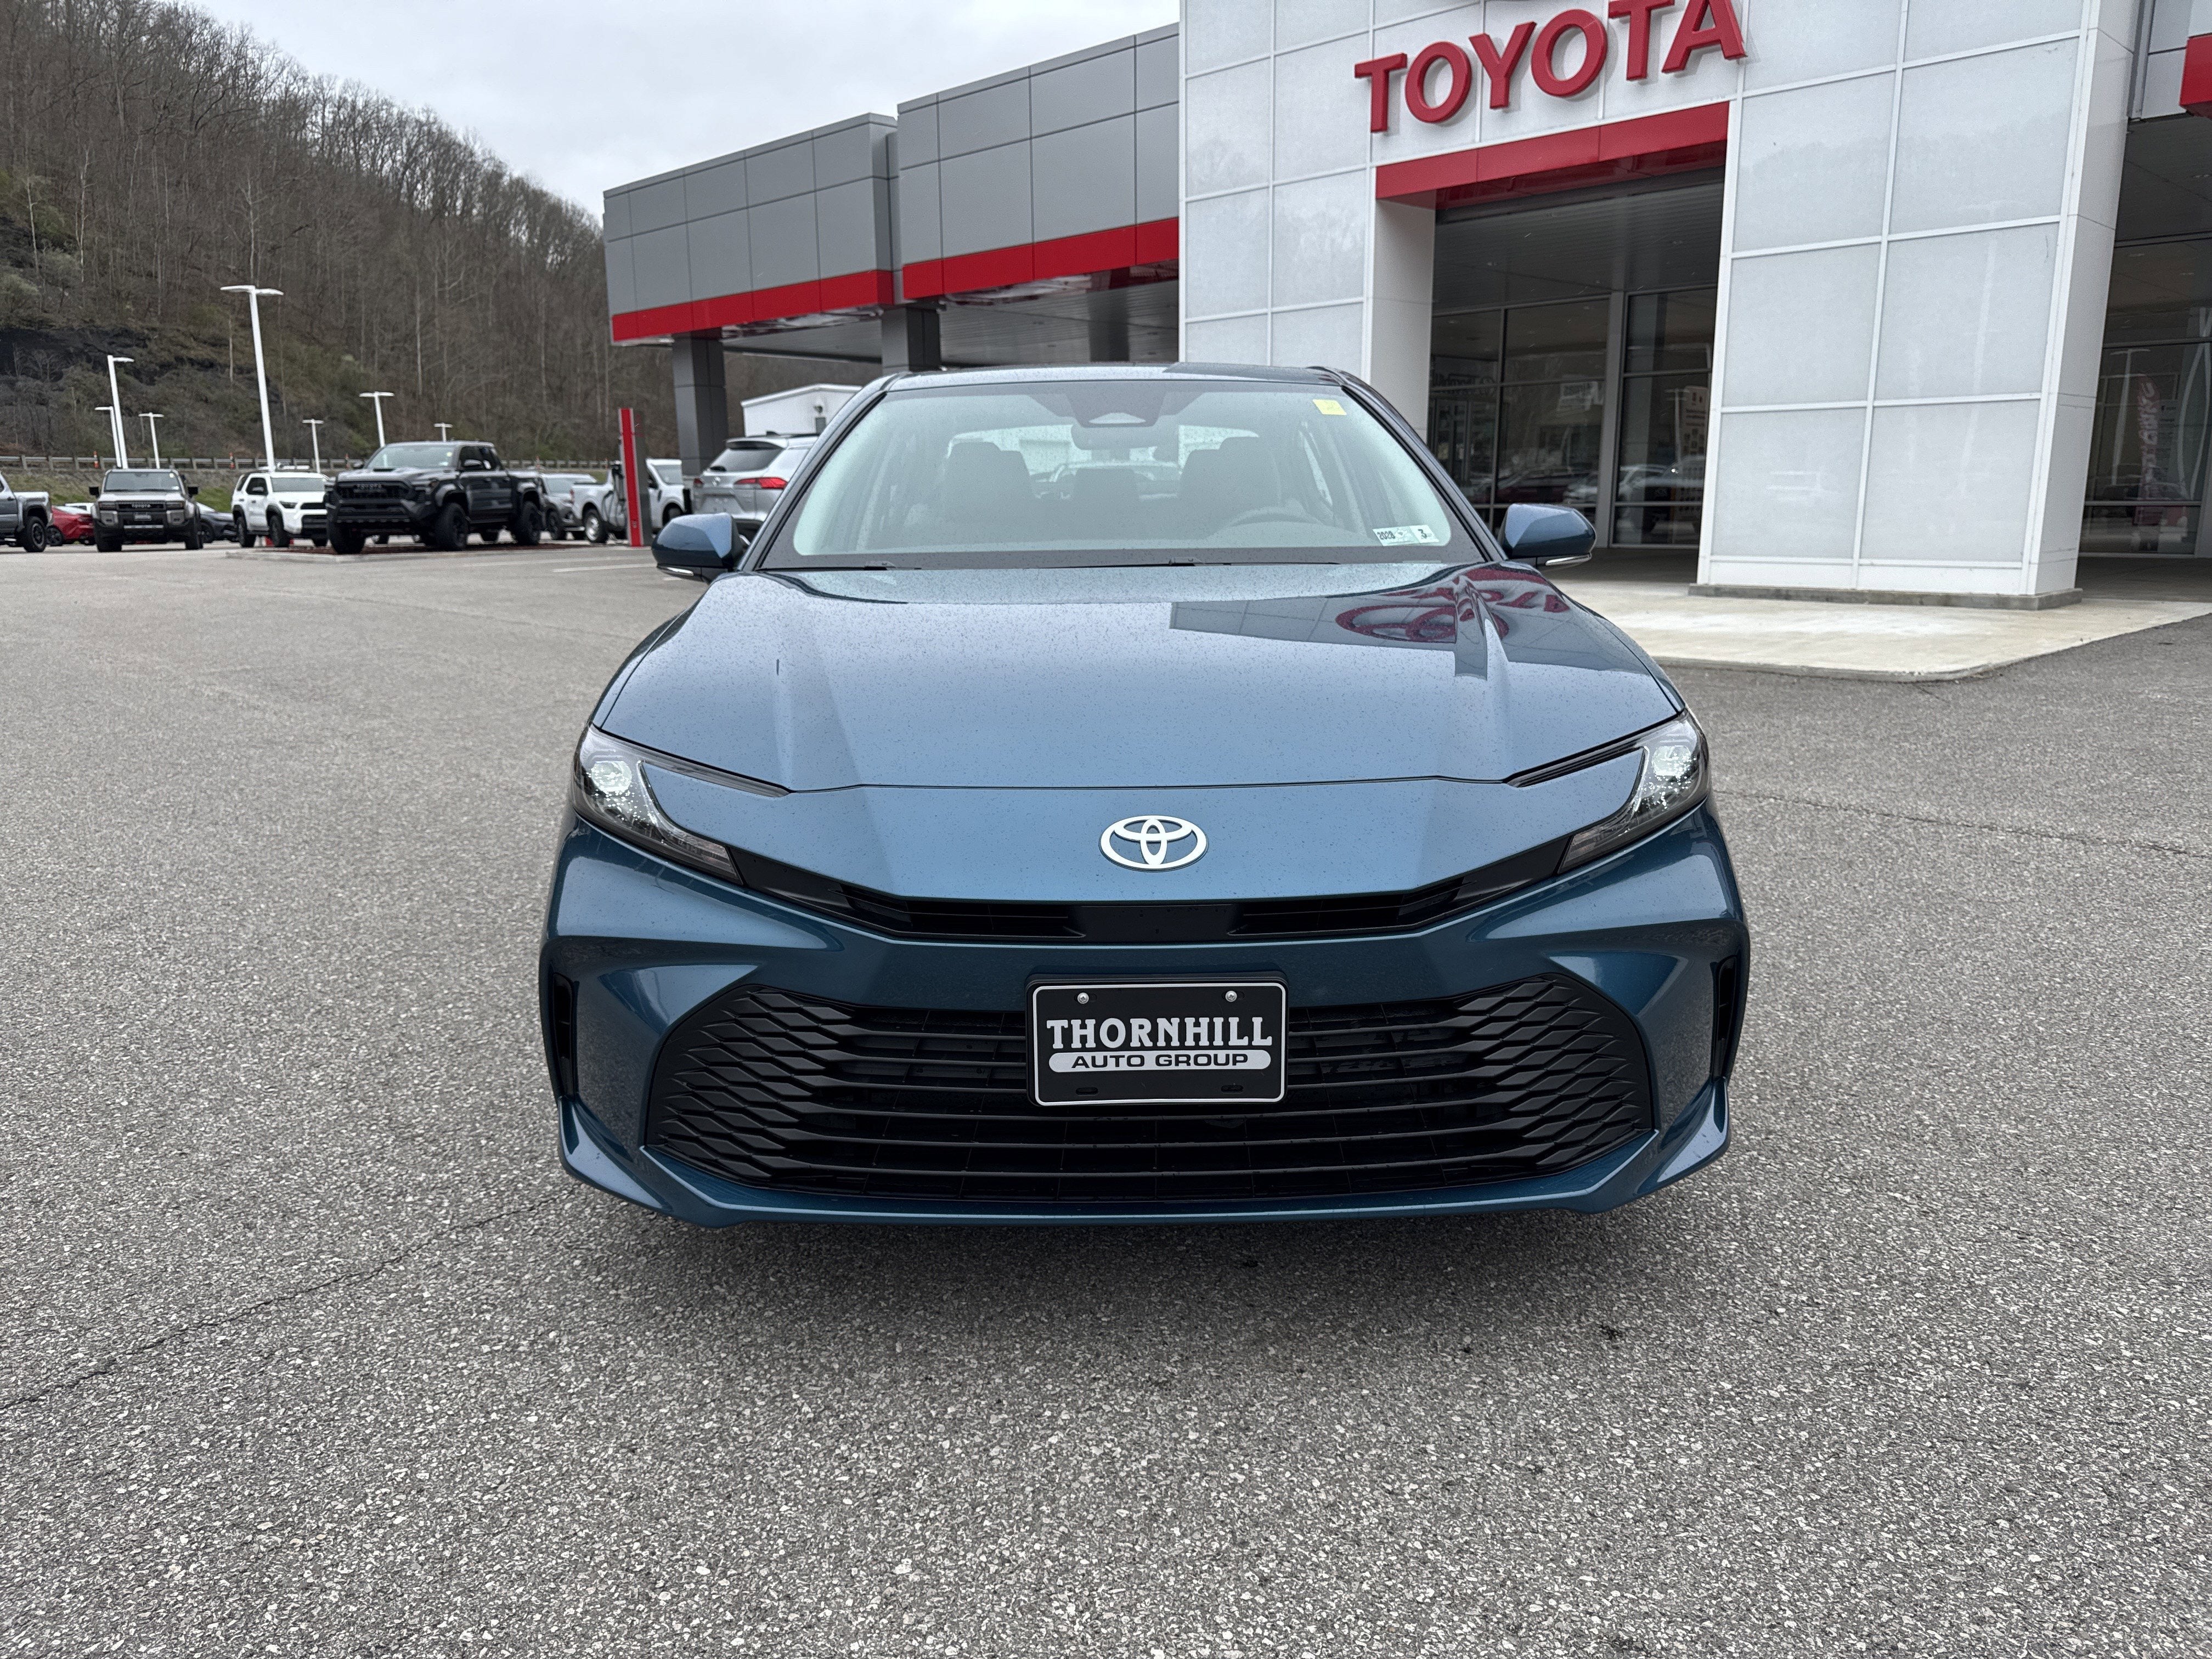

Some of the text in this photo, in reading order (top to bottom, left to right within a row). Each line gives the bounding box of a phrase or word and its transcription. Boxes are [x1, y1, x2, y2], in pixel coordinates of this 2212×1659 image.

[1354, 0, 1747, 133] TOYOTA
[1047, 1017, 1273, 1049] THORNHILL
[1071, 1053, 1249, 1069] AUTO GROUP
